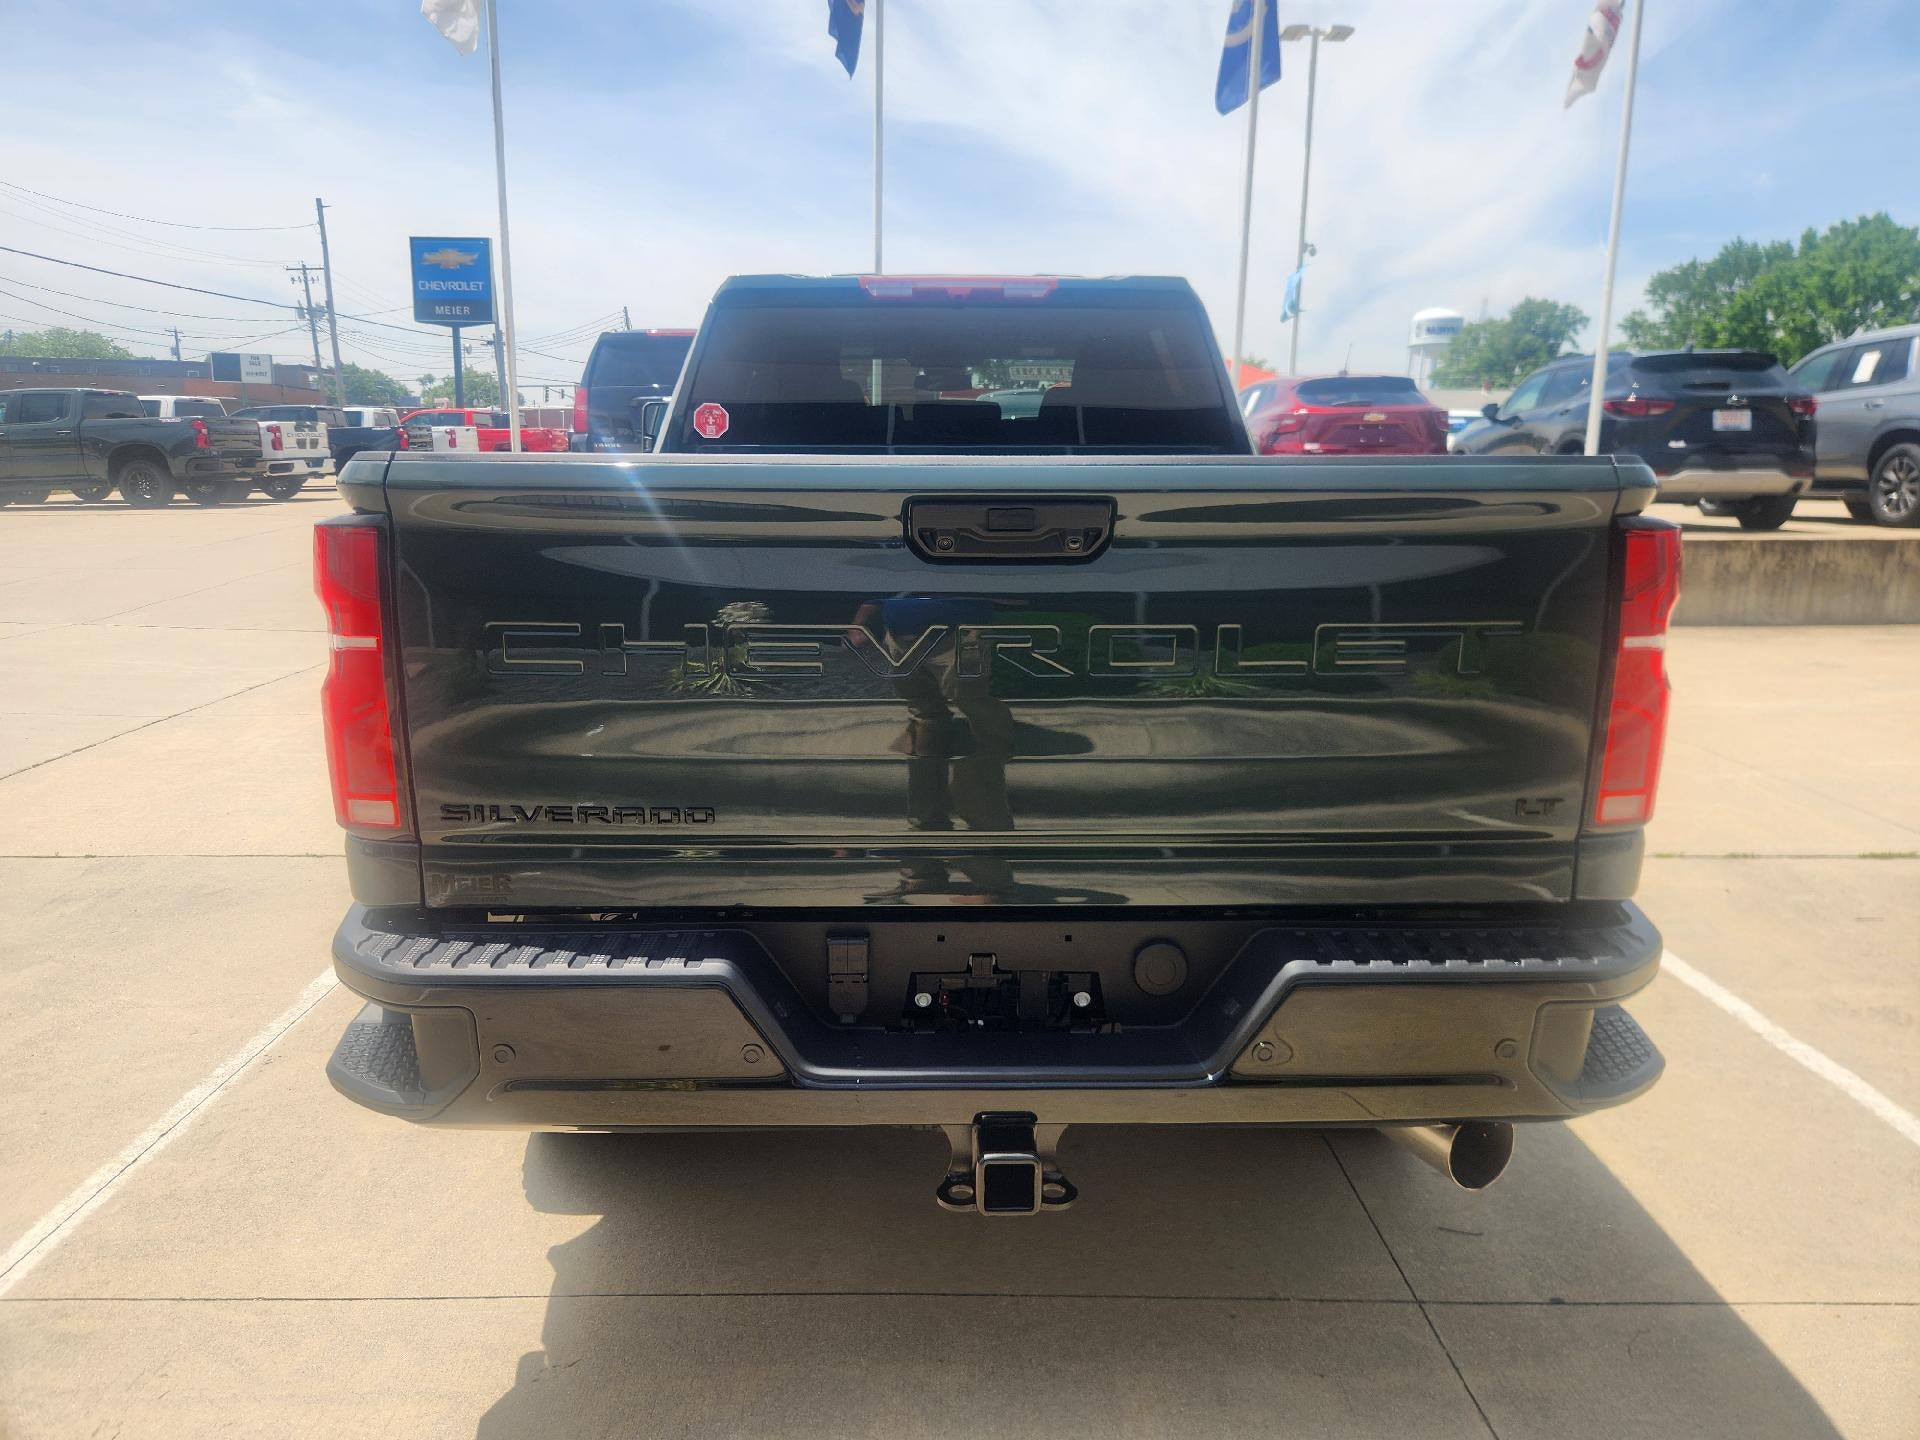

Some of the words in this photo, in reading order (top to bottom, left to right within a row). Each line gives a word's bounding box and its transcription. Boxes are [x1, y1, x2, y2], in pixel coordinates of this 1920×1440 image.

[418, 280, 484, 291] CHEVROLET
[434, 304, 471, 315] MEIER
[484, 621, 1524, 678] CHEVROLET
[440, 804, 716, 825] SILVERADO
[1515, 798, 1565, 816] LT
